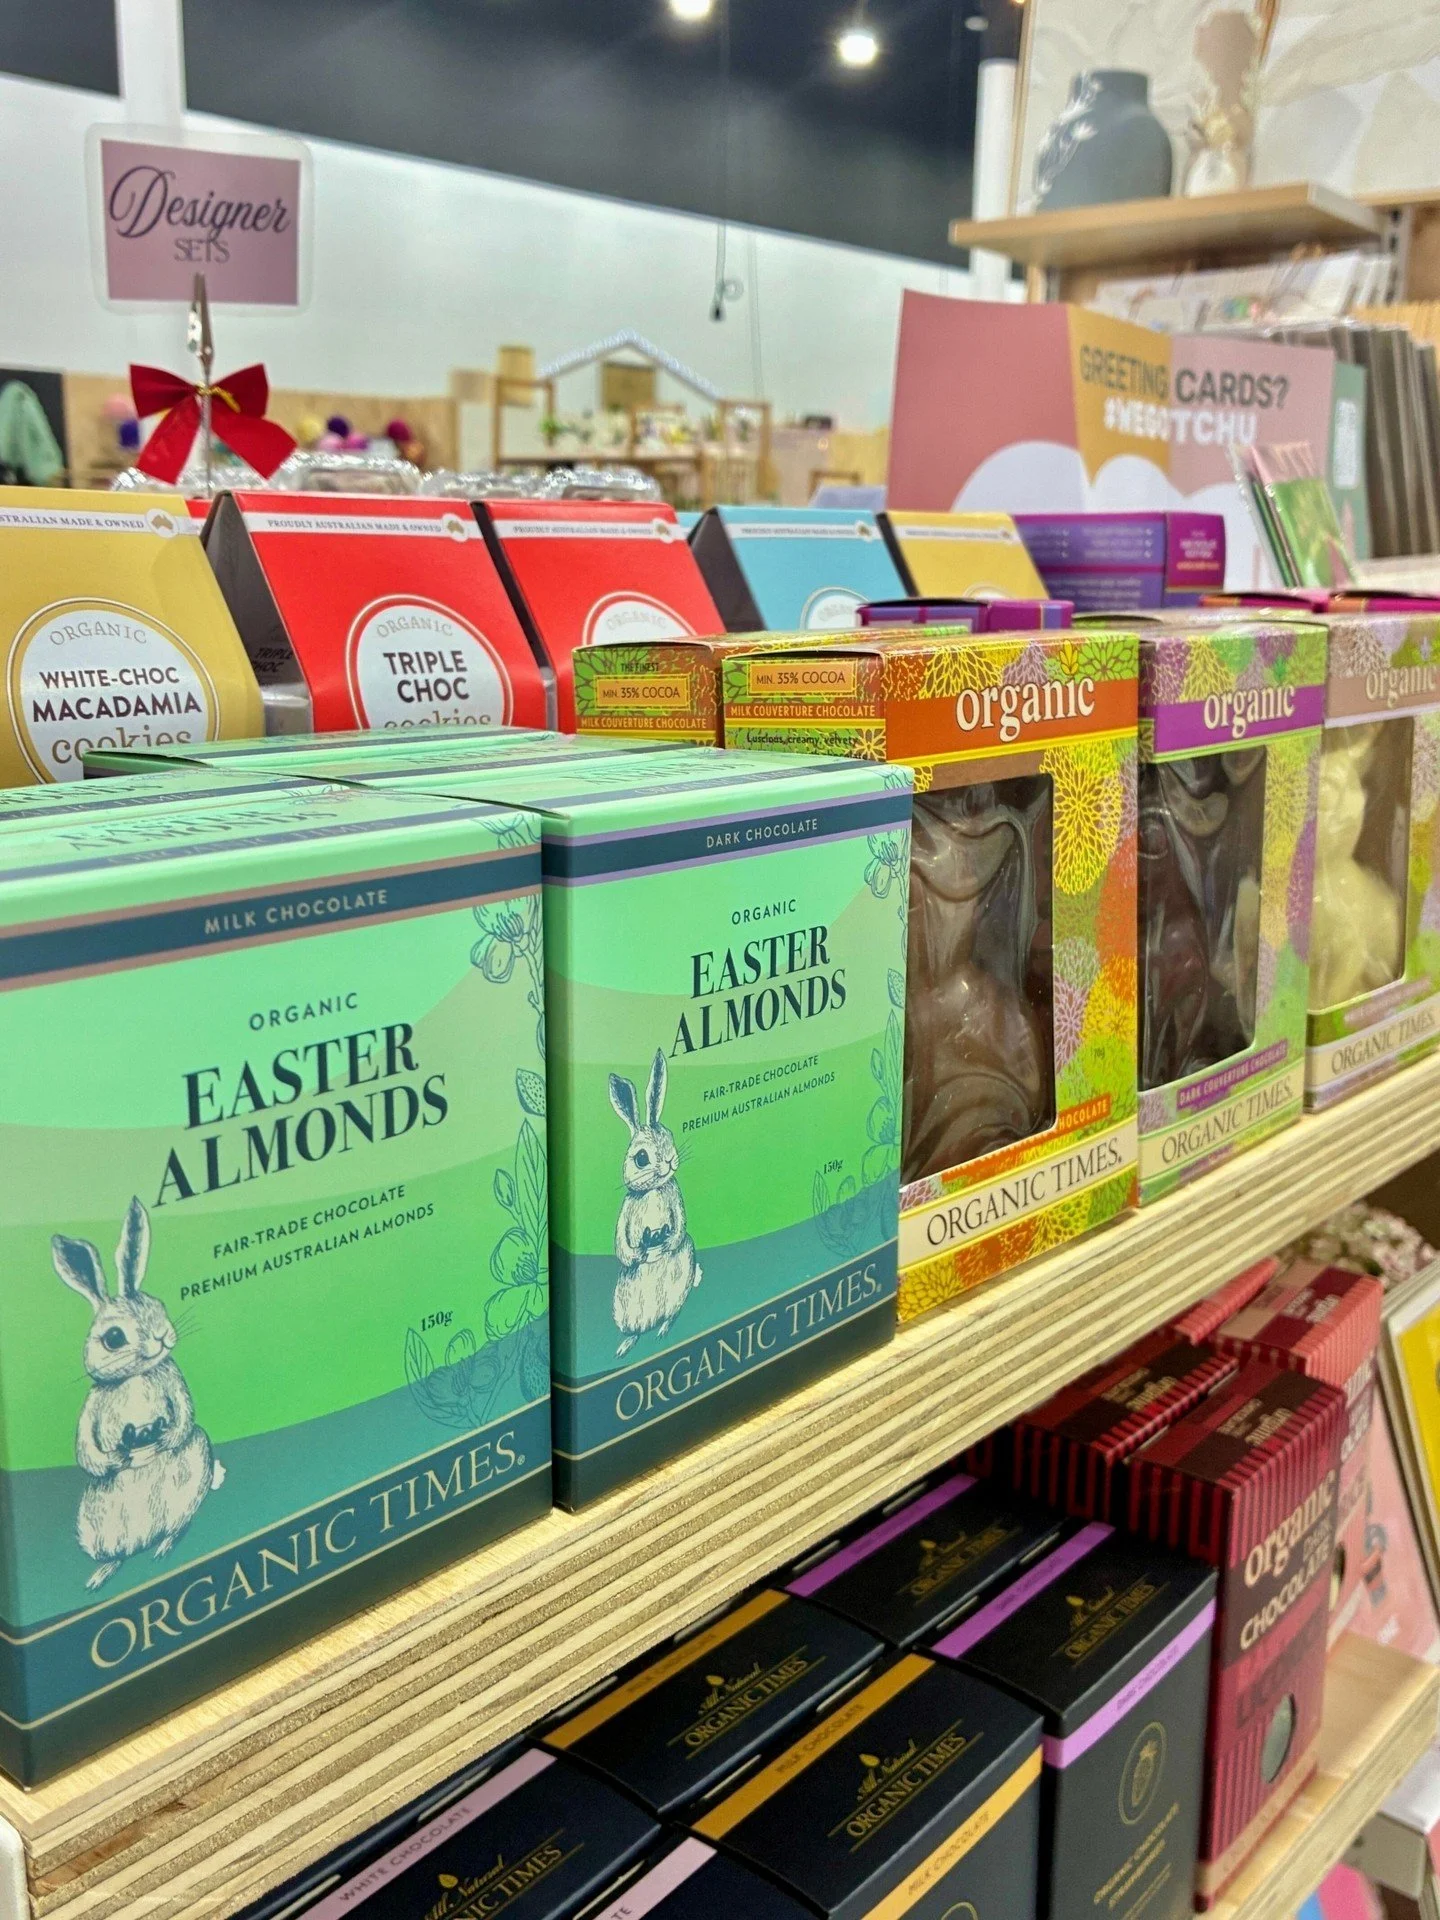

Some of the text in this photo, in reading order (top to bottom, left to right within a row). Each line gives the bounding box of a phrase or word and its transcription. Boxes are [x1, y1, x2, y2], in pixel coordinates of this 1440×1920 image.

[109, 165, 290, 241] Designer
[173, 238, 230, 263] SETS
[1080, 344, 1290, 409] GREETING CARDS?
[1103, 396, 1257, 446] #WEGOTCHU
[61, 516, 93, 526] MADE
[95, 519, 103, 528] &
[104, 519, 144, 529] OWNED
[267, 519, 313, 529] PROUDLY
[49, 621, 148, 646] ORGANIC
[375, 616, 453, 639] ORGANIC
[39, 666, 180, 689] WHITE-CHOC
[383, 650, 467, 675] TRIPLE
[777, 672, 799, 684] 35%
[801, 670, 846, 684] COCOA
[1365, 665, 1437, 709] organic
[32, 692, 202, 723] MACADAMIA
[396, 677, 470, 703] CHOC
[620, 686, 639, 699] 35%
[641, 686, 681, 699] COCOA
[730, 704, 876, 717] MILK COUVERTURE CHOCOLATE
[954, 675, 1096, 744] organic
[1203, 684, 1296, 740] organic
[581, 717, 707, 729] MILK COUVERTURE CHOCOLATE
[706, 818, 819, 849] DARK CHOCOLATE
[204, 888, 389, 936] MILK CHOCOLATE
[730, 898, 797, 926] ORGANIC
[689, 924, 831, 1000] EASTER
[248, 992, 359, 1032] ORGANIC
[668, 968, 847, 1060] ALMONDS
[1330, 1011, 1436, 1076] ORGANIC TIMES
[181, 1022, 420, 1132] EASTER
[702, 1054, 819, 1102] FAIR-TRADE CHOCOLATE
[681, 1070, 836, 1134] PREMIUM AUSTRALIAN ALMONDS
[1057, 1098, 1109, 1130] HOCOLATE
[1161, 1106, 1245, 1164] ORGANIC
[1246, 1075, 1293, 1123] TIMES
[151, 1073, 449, 1208] ALMONDS
[822, 1158, 844, 1174] 150g
[212, 1184, 407, 1259] FAIR-TRADE CHOCOLATE
[926, 1170, 1046, 1247] ORGANIC
[179, 1202, 435, 1301] PREMIUM AUSTRALIAN ALMONDS
[419, 1309, 455, 1333] 150g
[615, 1312, 778, 1422] ORGANIC
[1244, 1468, 1337, 1588] organic
[90, 1506, 358, 1670] ORGANIC
[1239, 1534, 1332, 1650] CHOCOLATE
[684, 1687, 763, 1747] ORGANIC
[759, 1658, 808, 1694] TIMES
[846, 1732, 967, 1837] ORGANIC TIMES
[339, 1805, 473, 1904] WHITE CHOCOLATE
[458, 1853, 504, 1897] Natural
[492, 1844, 563, 1897] TIMES
